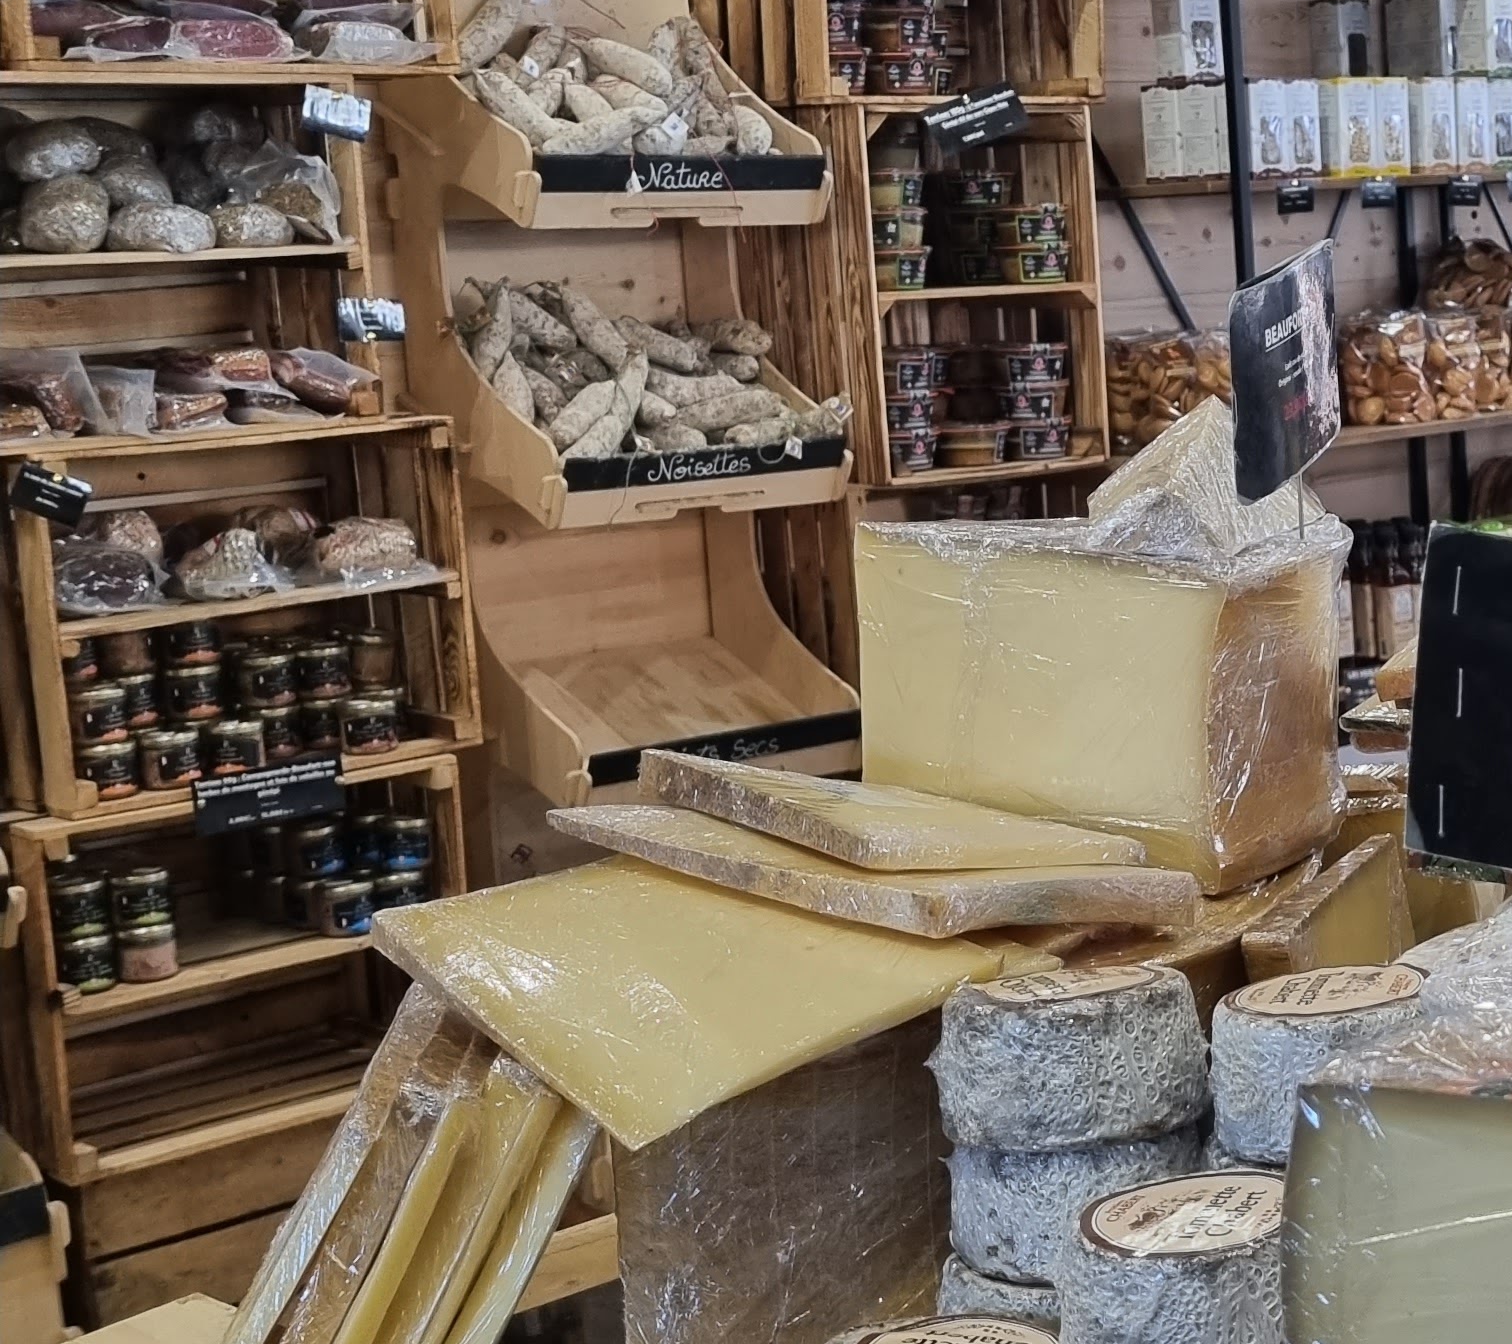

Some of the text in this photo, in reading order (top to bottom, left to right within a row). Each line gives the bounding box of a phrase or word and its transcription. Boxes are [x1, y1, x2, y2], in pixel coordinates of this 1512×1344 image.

[638, 162, 723, 191] Nature
[1265, 307, 1306, 348] BEAUFOR
[648, 453, 751, 482] Noisettes
